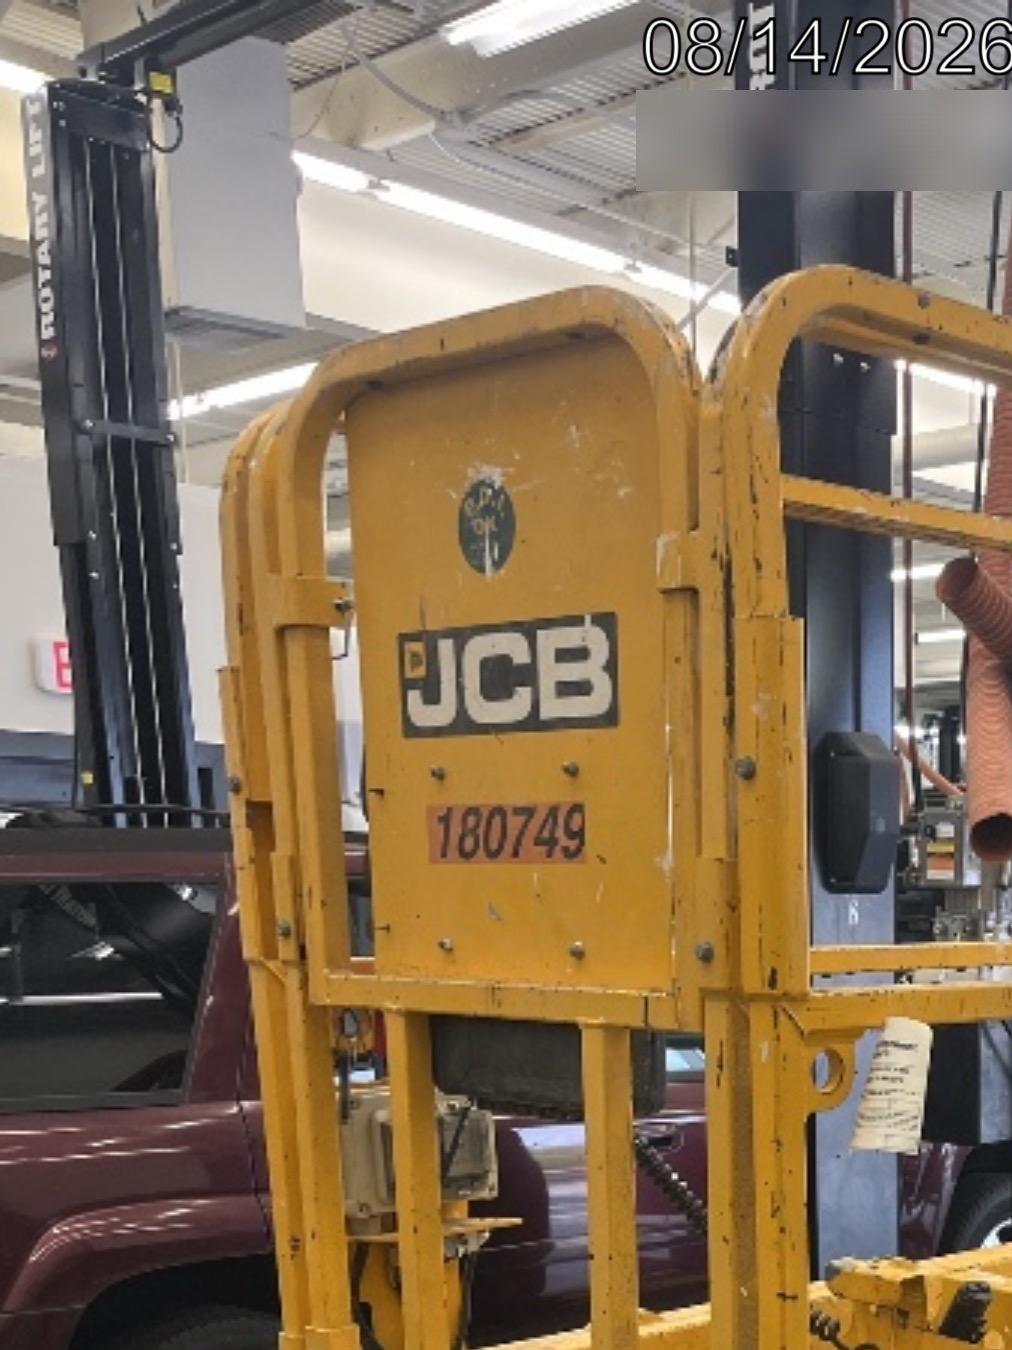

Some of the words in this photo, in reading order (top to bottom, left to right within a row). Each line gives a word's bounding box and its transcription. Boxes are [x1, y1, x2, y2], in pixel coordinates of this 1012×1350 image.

[31, 191, 57, 339] ROTARY
[406, 624, 613, 728] JCB
[437, 803, 586, 860] 180749
